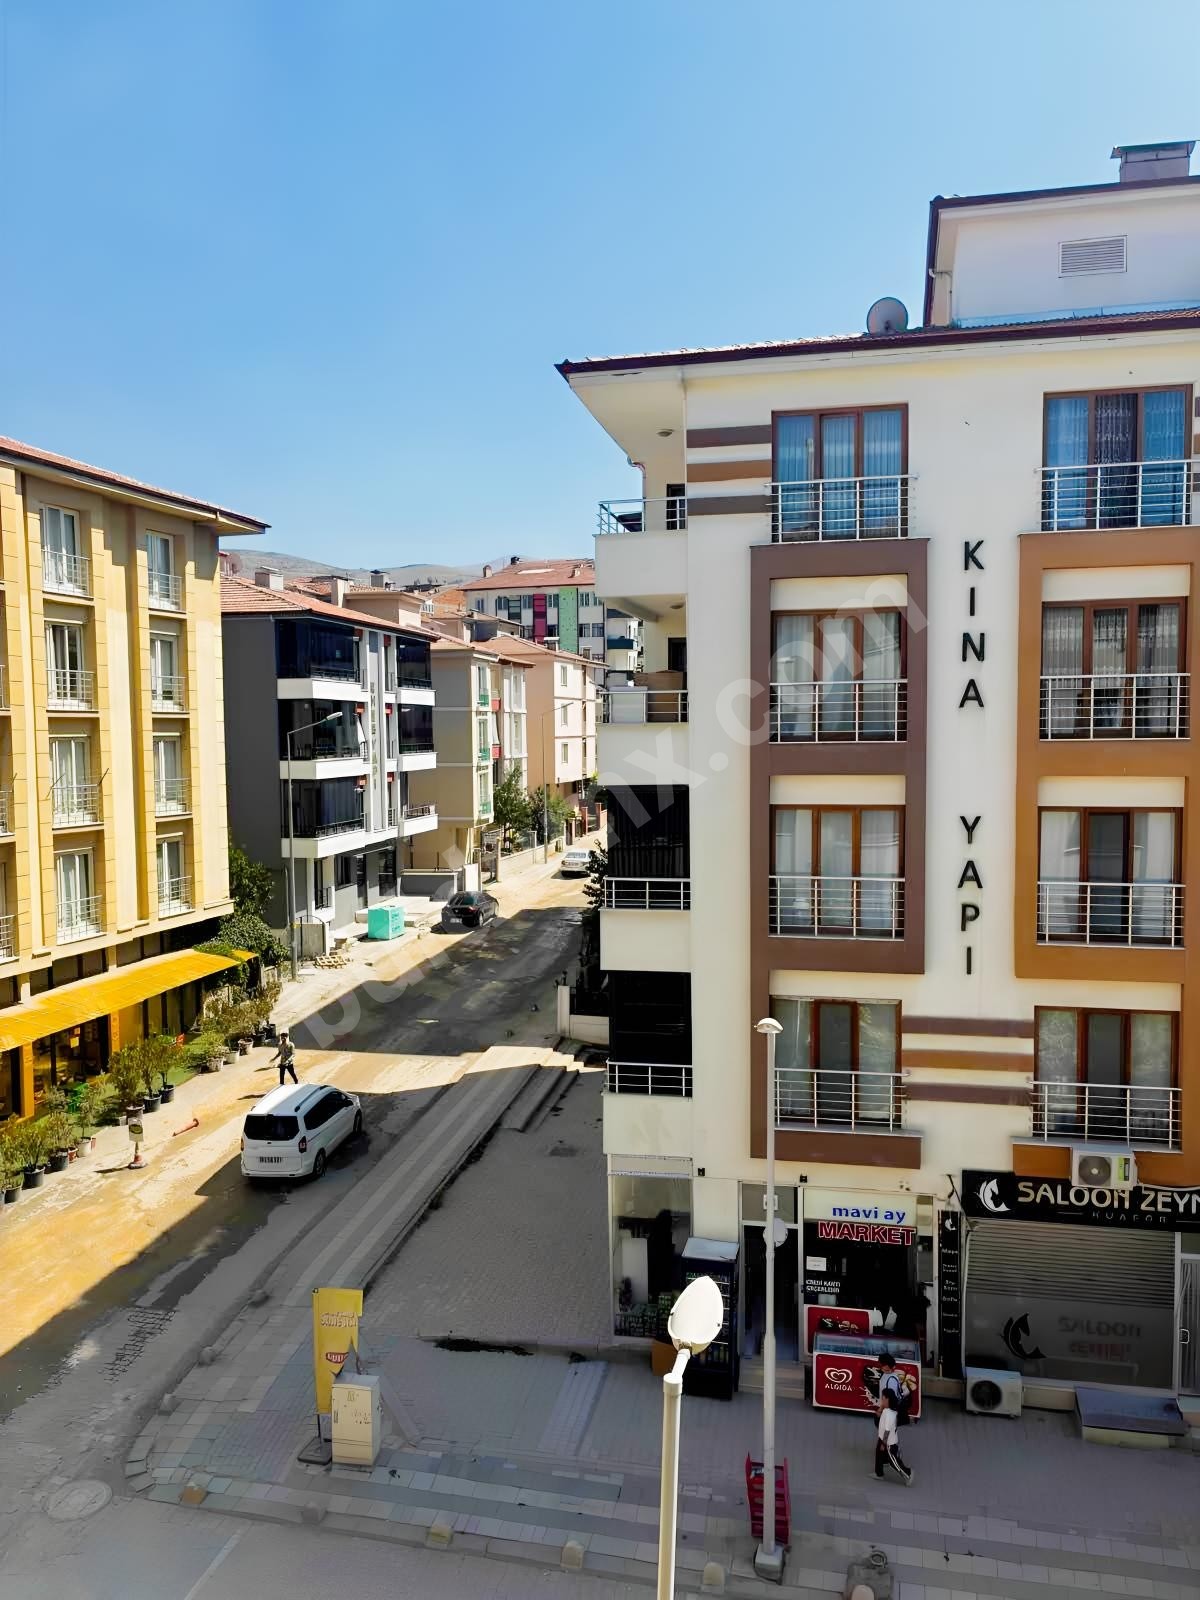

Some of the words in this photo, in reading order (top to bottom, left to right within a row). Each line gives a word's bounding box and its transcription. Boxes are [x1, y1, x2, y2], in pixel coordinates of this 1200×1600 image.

[958, 540, 985, 708] KINA
[957, 815, 983, 975] YAPI
[1017, 1181, 1131, 1210] SALOON
[832, 1206, 878, 1219] mavi
[884, 1209, 906, 1225] ay
[818, 1220, 915, 1246] MARKET
